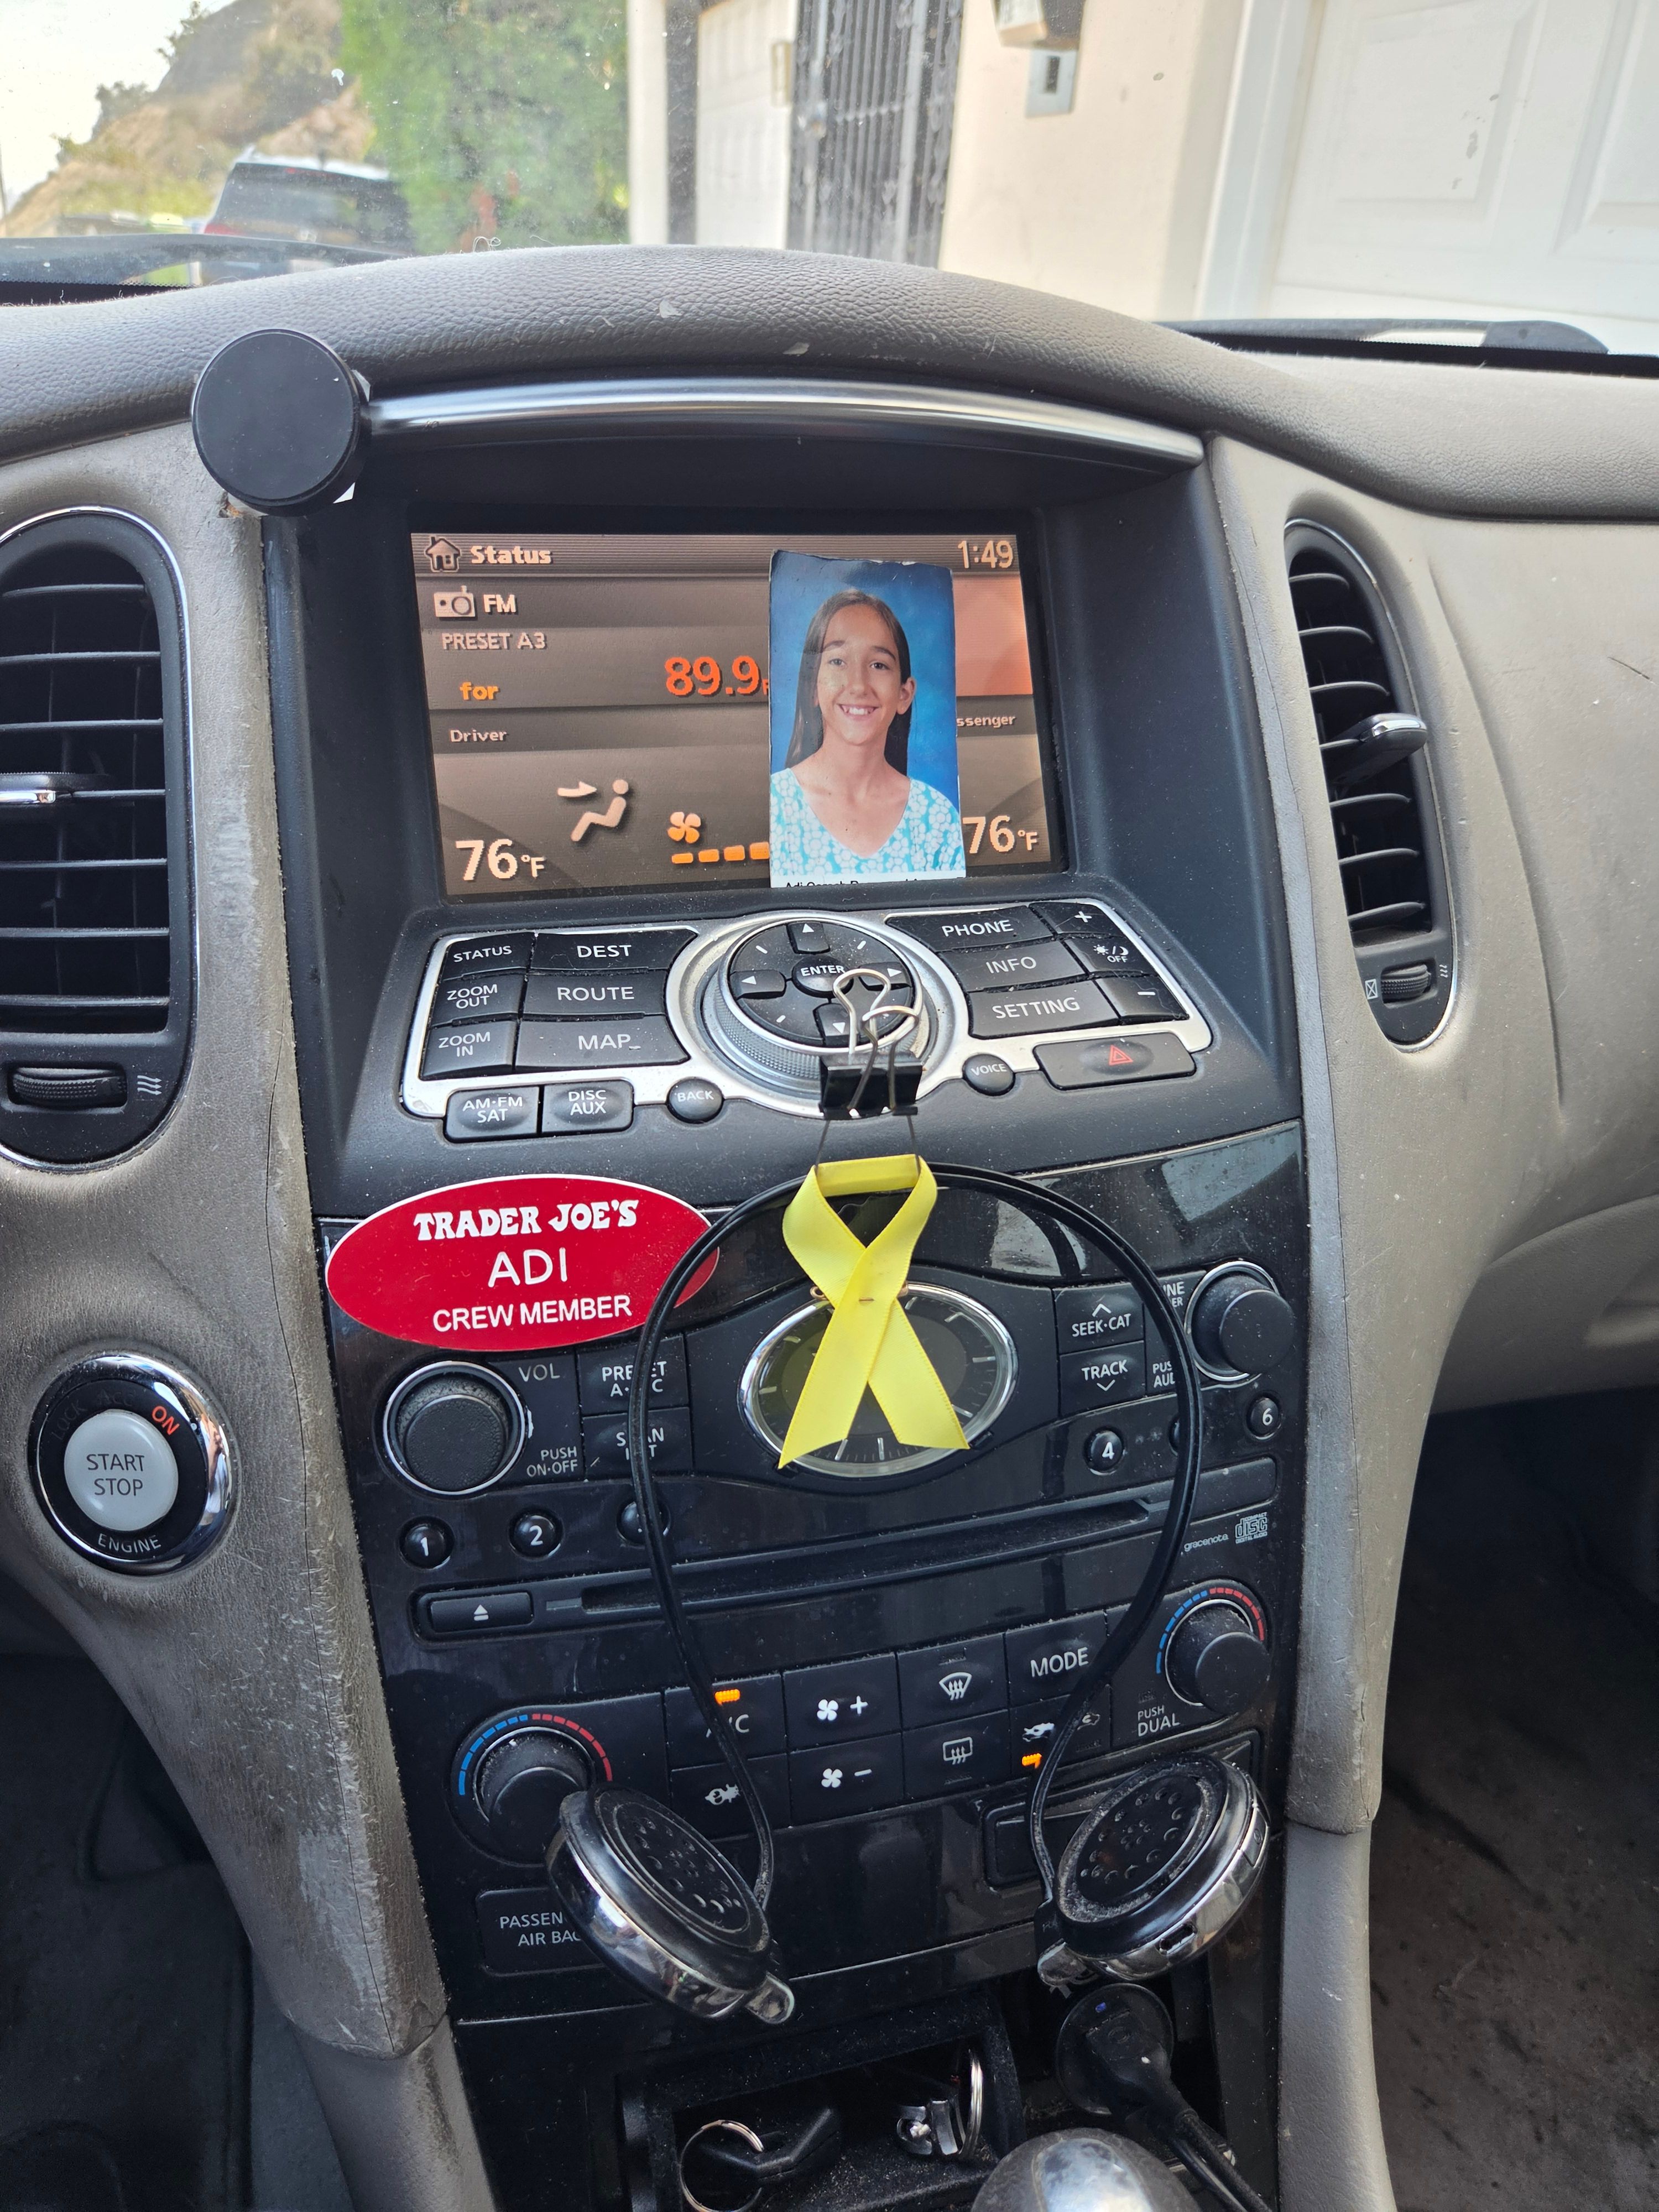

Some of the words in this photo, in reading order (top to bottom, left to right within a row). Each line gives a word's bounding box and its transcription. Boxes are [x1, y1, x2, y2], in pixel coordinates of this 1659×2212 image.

[469, 544, 552, 565] Status
[956, 539, 1014, 570] 1:49
[483, 594, 517, 613] FM
[441, 632, 512, 651] PRESET
[517, 632, 547, 650] A3
[665, 655, 760, 696] 89.9
[459, 681, 500, 701] for
[956, 716, 1016, 728] ssenger
[449, 728, 508, 744] Driver
[941, 918, 1014, 938] PHONE
[452, 945, 513, 963] STATUS
[576, 943, 632, 958] DEST
[1108, 953, 1129, 963] OFF
[800, 964, 846, 977] ENTER
[985, 956, 1037, 975] INFO
[446, 984, 498, 1001] ZOOM
[557, 986, 636, 1001] ROUTE
[455, 995, 490, 1009] OUT
[991, 997, 1082, 1020] SETTING
[438, 1031, 491, 1049] ZOOM
[578, 1034, 631, 1050] MAP
[456, 1045, 474, 1057] IN
[971, 1061, 1008, 1076] VOICE
[568, 1089, 607, 1102] DISC
[676, 1089, 714, 1102] BACK
[477, 1108, 508, 1123] SAT
[570, 1102, 607, 1115] AUX
[414, 1207, 541, 1241] TRADER
[547, 1199, 639, 1233] JOE'S
[488, 1247, 567, 1288] ADI
[1162, 1281, 1186, 1297] NE
[433, 1303, 514, 1332] CREW
[520, 1294, 633, 1325] MEMBER
[519, 1363, 560, 1381] VOL
[602, 1361, 667, 1382] PRET
[1082, 1359, 1128, 1381] TRACK
[1152, 1360, 1173, 1374] PUS
[152, 1406, 179, 1436] ON
[1261, 1411, 1273, 1426] 6
[615, 1427, 664, 1447] SN
[541, 1446, 577, 1460] PUSH
[1102, 1442, 1114, 1459] 4
[86, 1453, 144, 1472] START
[93, 1478, 144, 1496] STOP
[97, 1532, 161, 1553] ENGINE
[530, 1525, 544, 1546] 2
[419, 1537, 429, 1556] 1
[1031, 1647, 1089, 1677] MODE
[1138, 1705, 1165, 1721] PUSH
[1138, 1713, 1180, 1736] DUAL
[500, 1911, 563, 1929] PASSEN
[518, 1933, 546, 1947] AIR
